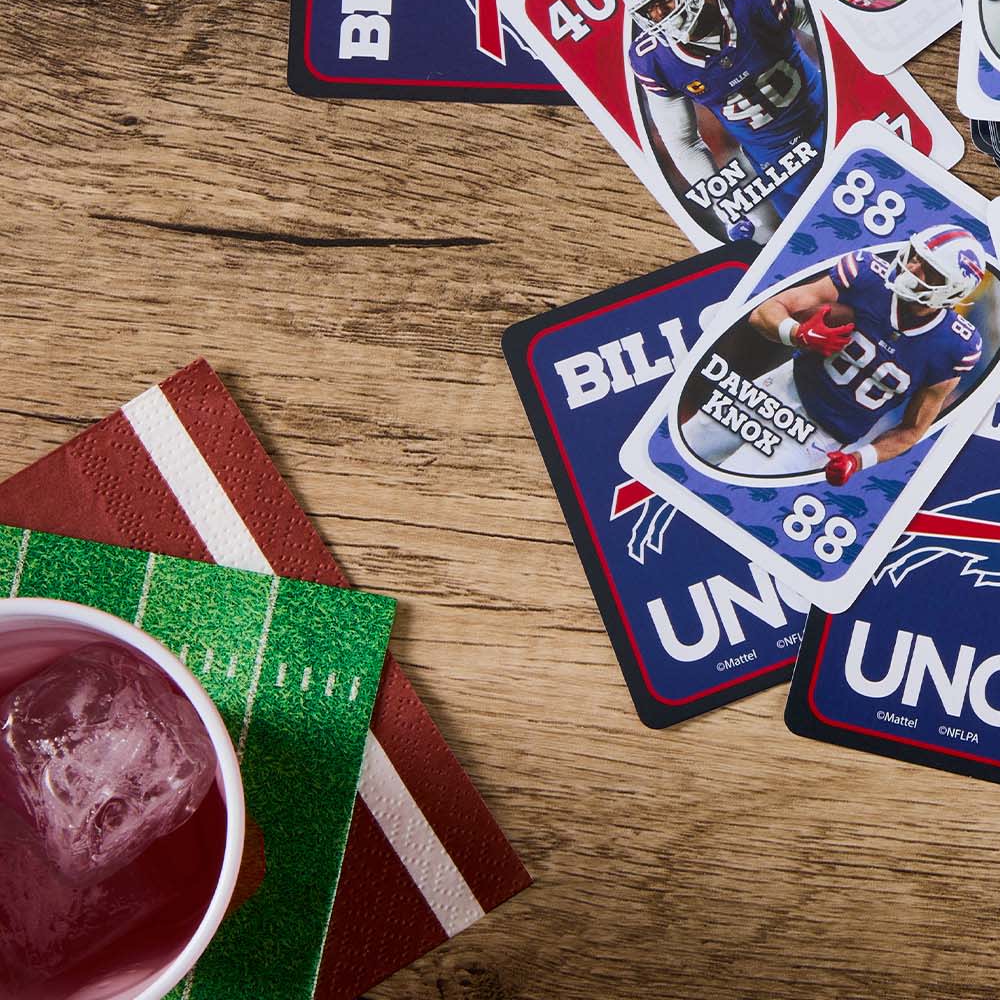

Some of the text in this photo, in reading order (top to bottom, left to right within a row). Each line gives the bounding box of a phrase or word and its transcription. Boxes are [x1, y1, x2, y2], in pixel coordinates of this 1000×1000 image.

[722, 59, 803, 131] 40
[684, 157, 748, 211] VON
[719, 140, 820, 223] MILLER
[832, 169, 907, 237] 88
[553, 303, 733, 411] BILL
[823, 331, 911, 411] 88
[699, 353, 817, 445] DAWSON
[700, 389, 781, 458] KNOX
[781, 494, 858, 564] 88
[716, 649, 758, 673] ©Mattel
[875, 710, 980, 745] ©Mattel ©NFLPA
